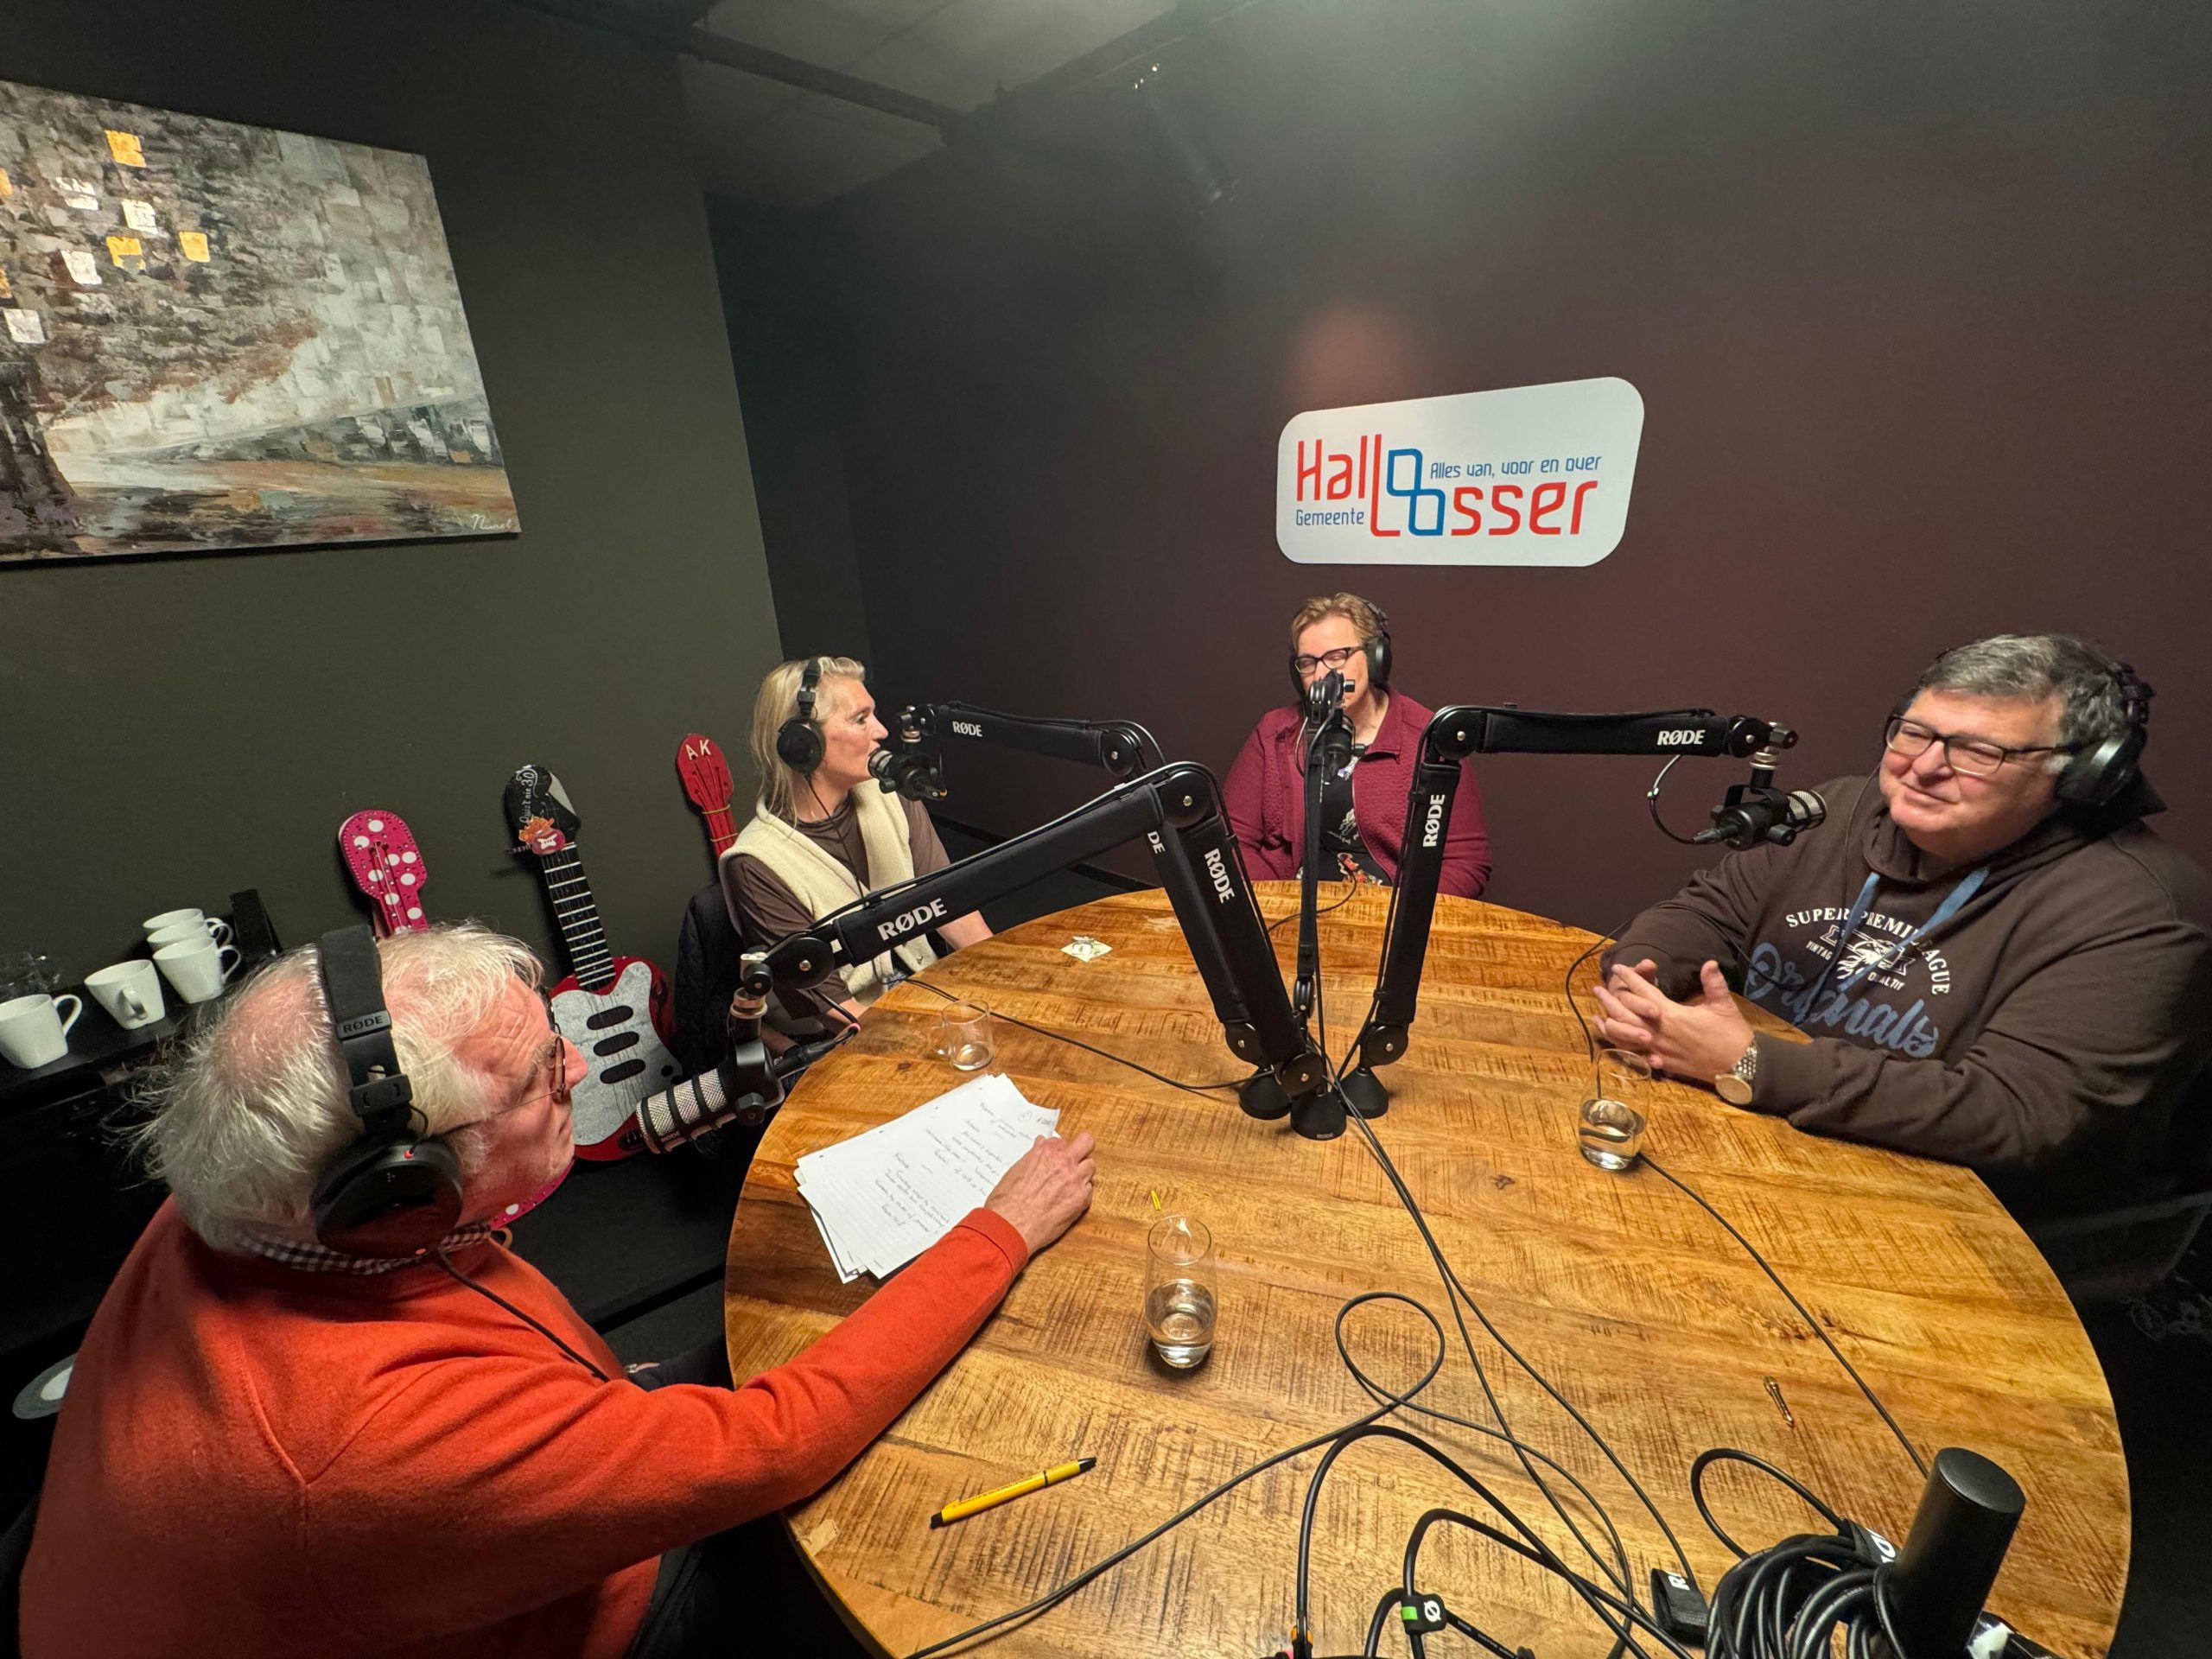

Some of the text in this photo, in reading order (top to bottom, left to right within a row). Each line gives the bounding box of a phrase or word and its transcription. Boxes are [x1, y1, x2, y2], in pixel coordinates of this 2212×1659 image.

[1430, 455, 1602, 479] Alles van, voor en over
[1296, 508, 1365, 526] Gemeente
[1657, 729, 1706, 746] RØDE
[521, 772, 535, 787] 30
[1422, 794, 1446, 848] RØDE
[1147, 831, 1166, 855] DE
[1205, 848, 1235, 904] RØDE
[877, 898, 948, 941] RØDE
[1785, 907, 1848, 928] SUPER
[1806, 940, 1834, 961] VINTAG
[343, 1015, 384, 1033] RØDE
